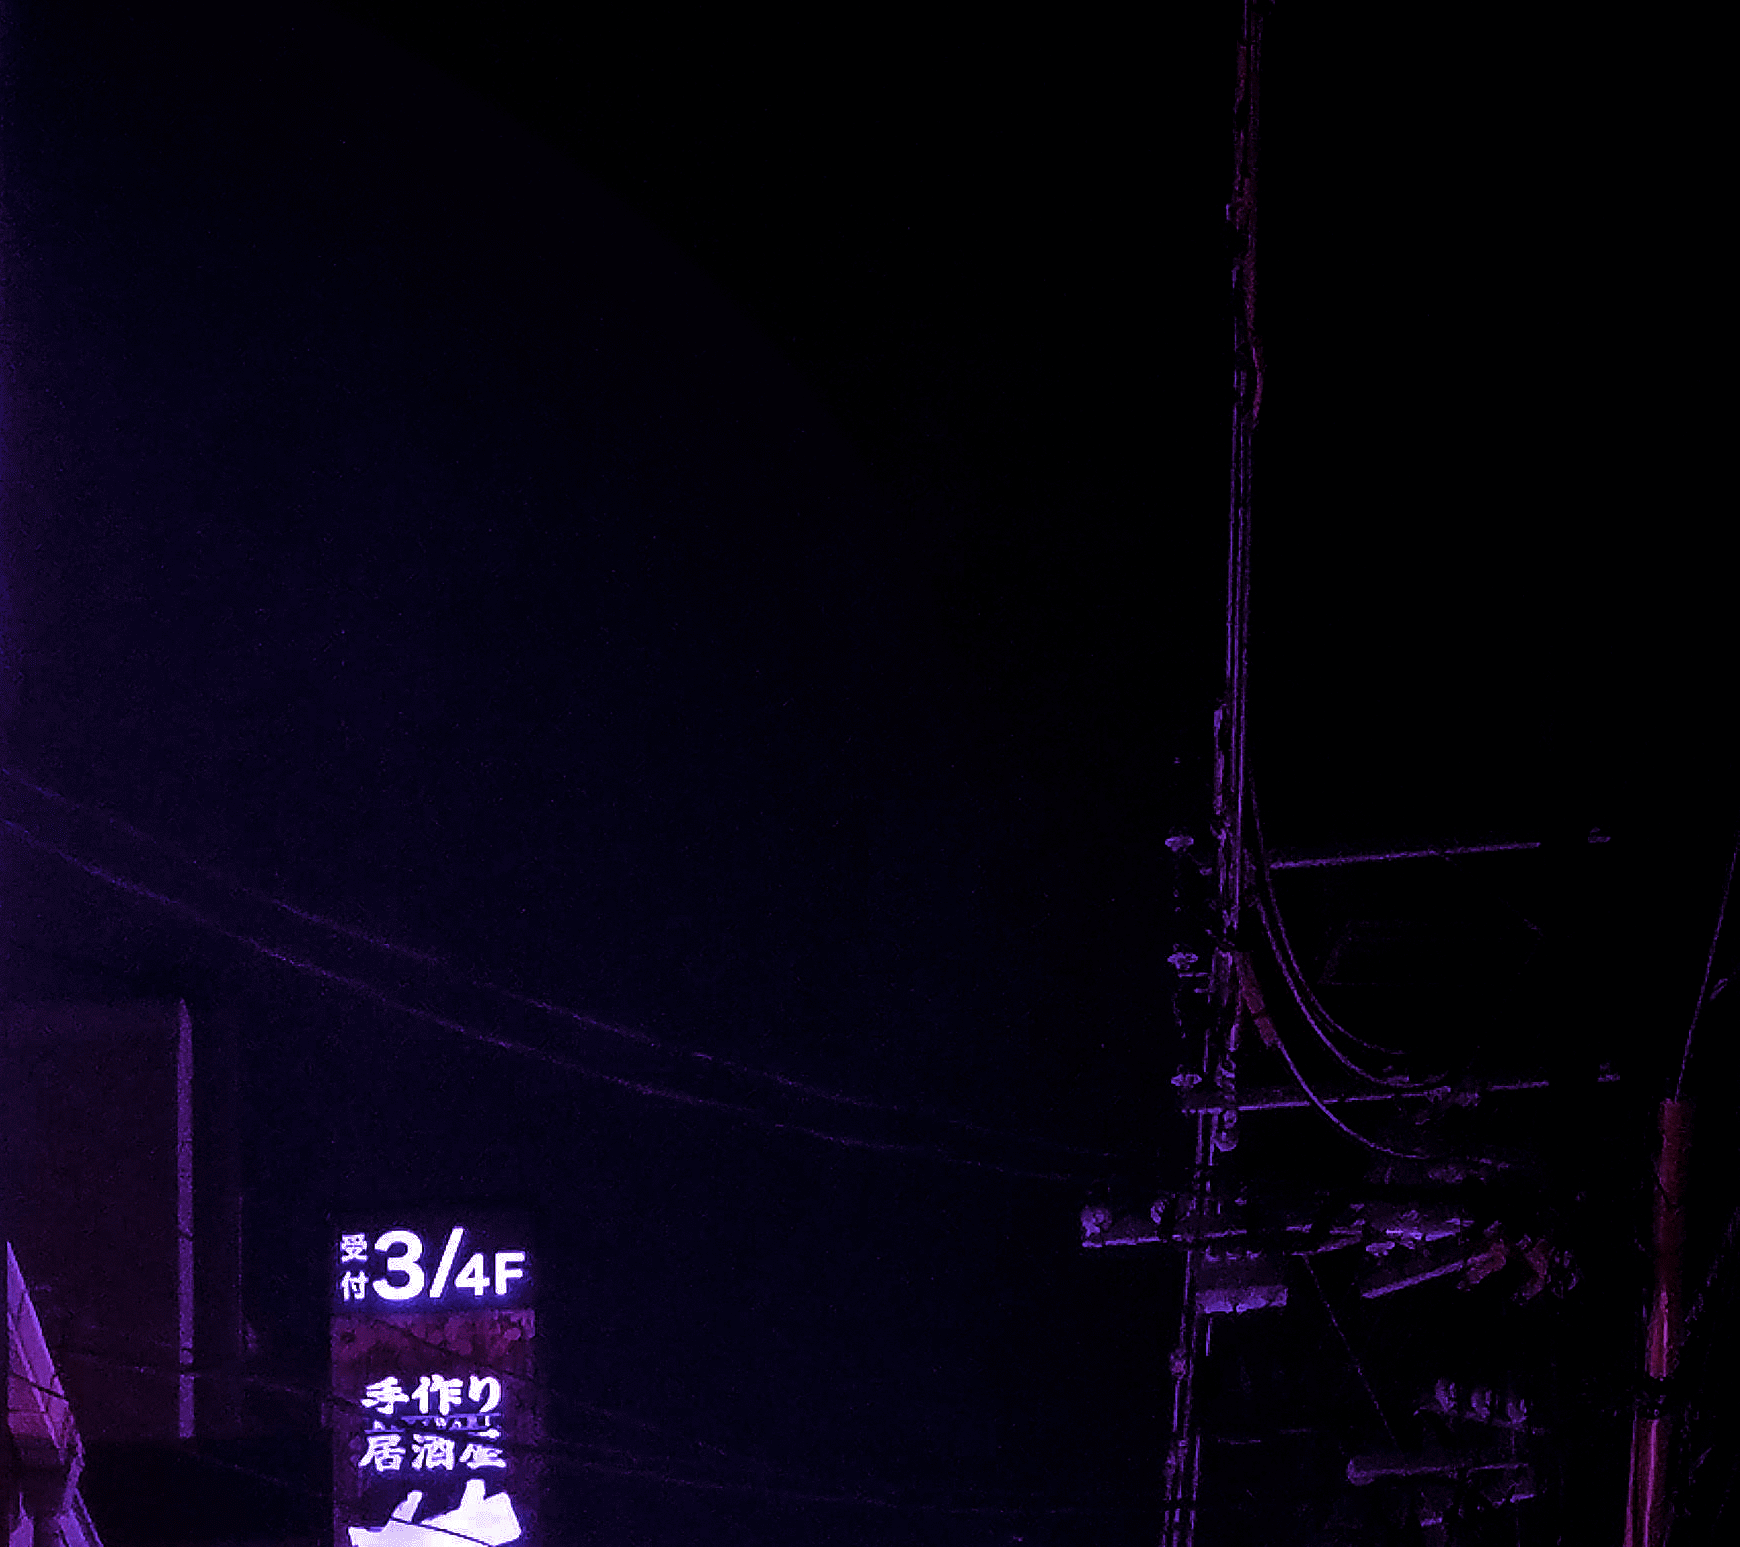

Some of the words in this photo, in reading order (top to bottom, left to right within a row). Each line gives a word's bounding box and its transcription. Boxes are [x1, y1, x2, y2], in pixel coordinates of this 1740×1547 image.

[340, 1232, 369, 1301] 受付
[372, 1225, 526, 1301] 3/4F
[361, 1374, 502, 1416] 手作り
